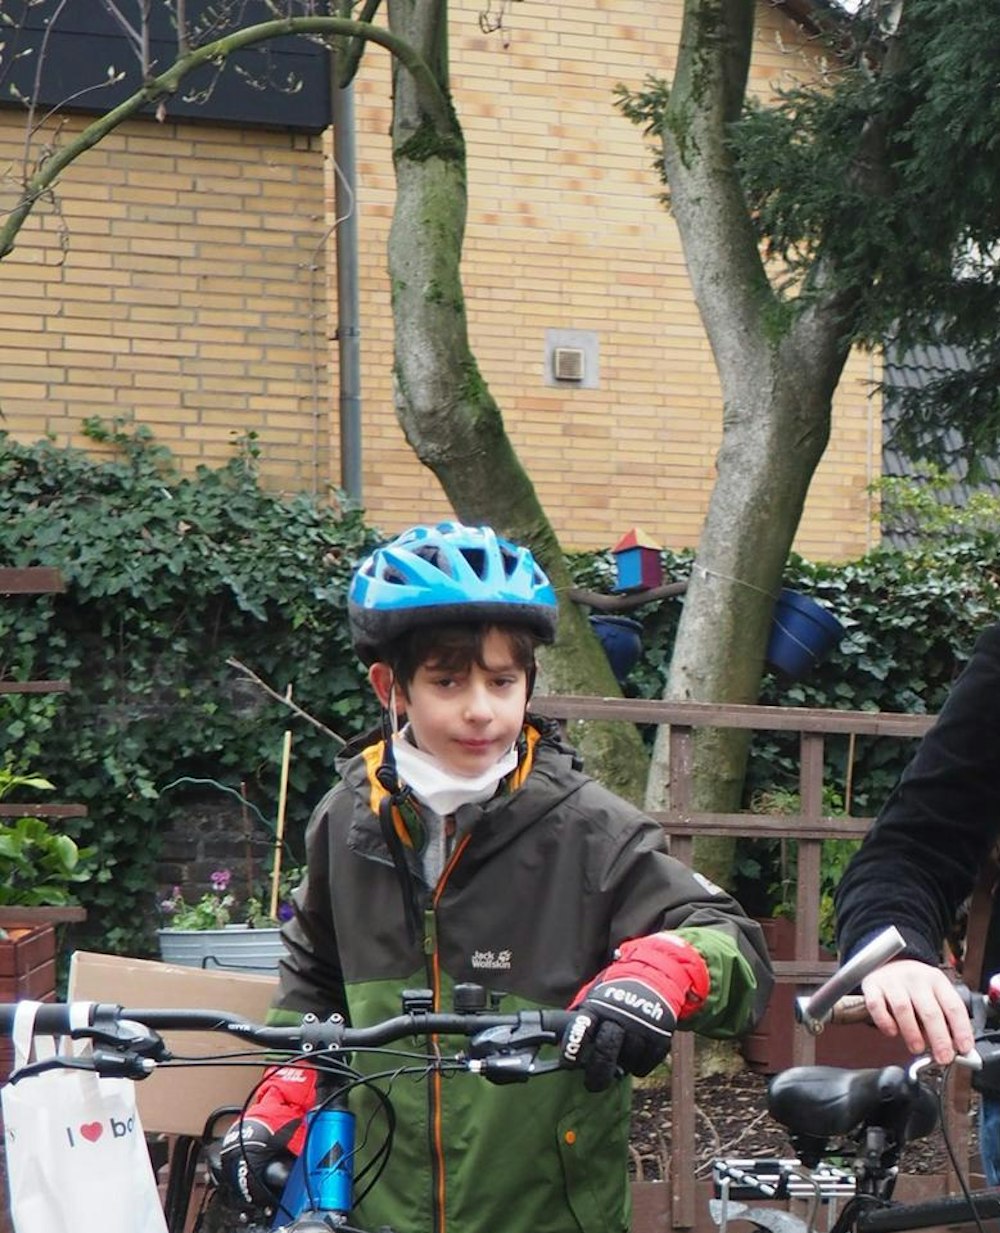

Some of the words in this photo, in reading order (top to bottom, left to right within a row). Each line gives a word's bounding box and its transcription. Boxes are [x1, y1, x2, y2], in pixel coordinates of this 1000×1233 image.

[472, 950, 494, 960] Jack
[472, 959, 511, 969] Wolfskin
[604, 986, 664, 1020] reusch
[564, 1015, 592, 1062] racing
